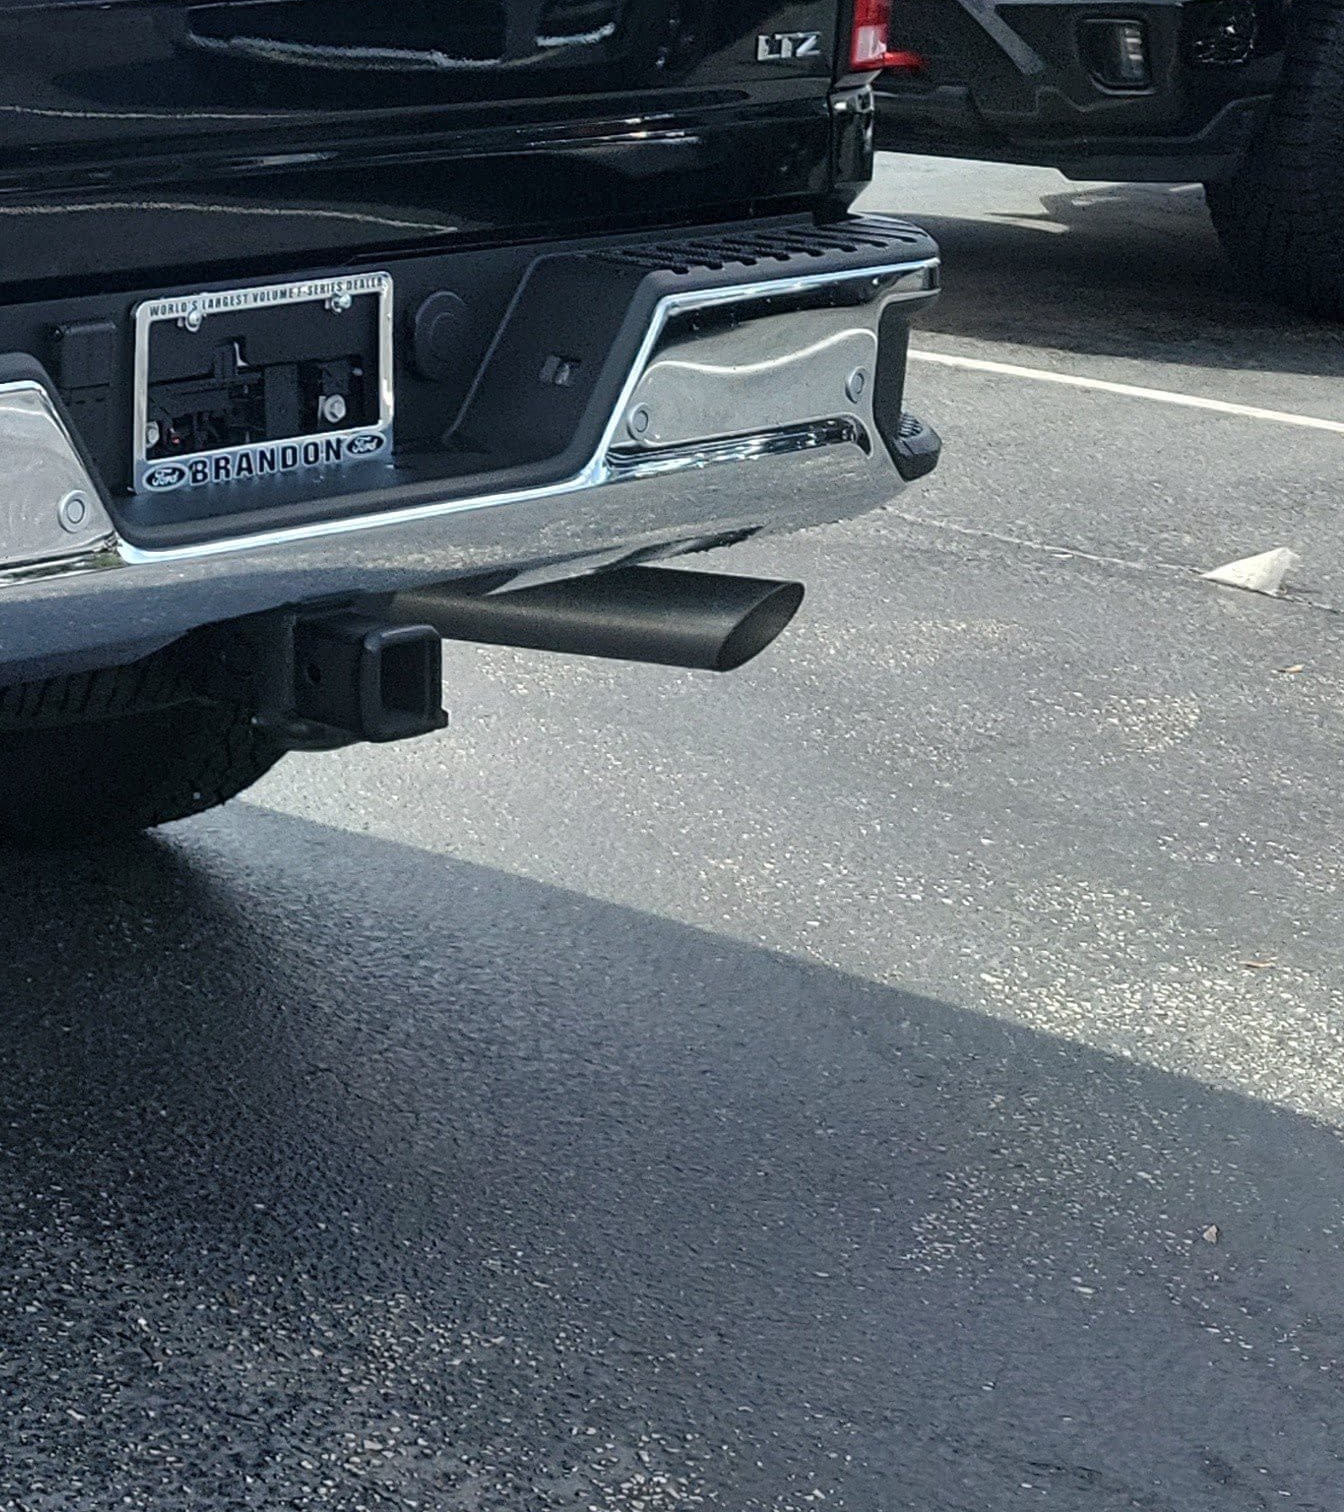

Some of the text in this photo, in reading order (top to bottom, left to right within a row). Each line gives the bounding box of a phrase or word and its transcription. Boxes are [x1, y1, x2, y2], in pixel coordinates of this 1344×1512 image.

[757, 31, 822, 61] LTZ
[202, 293, 249, 310] LARGEST
[252, 287, 294, 303] VOLUME
[346, 276, 383, 291] DEALER
[189, 437, 343, 485] BRANDON
